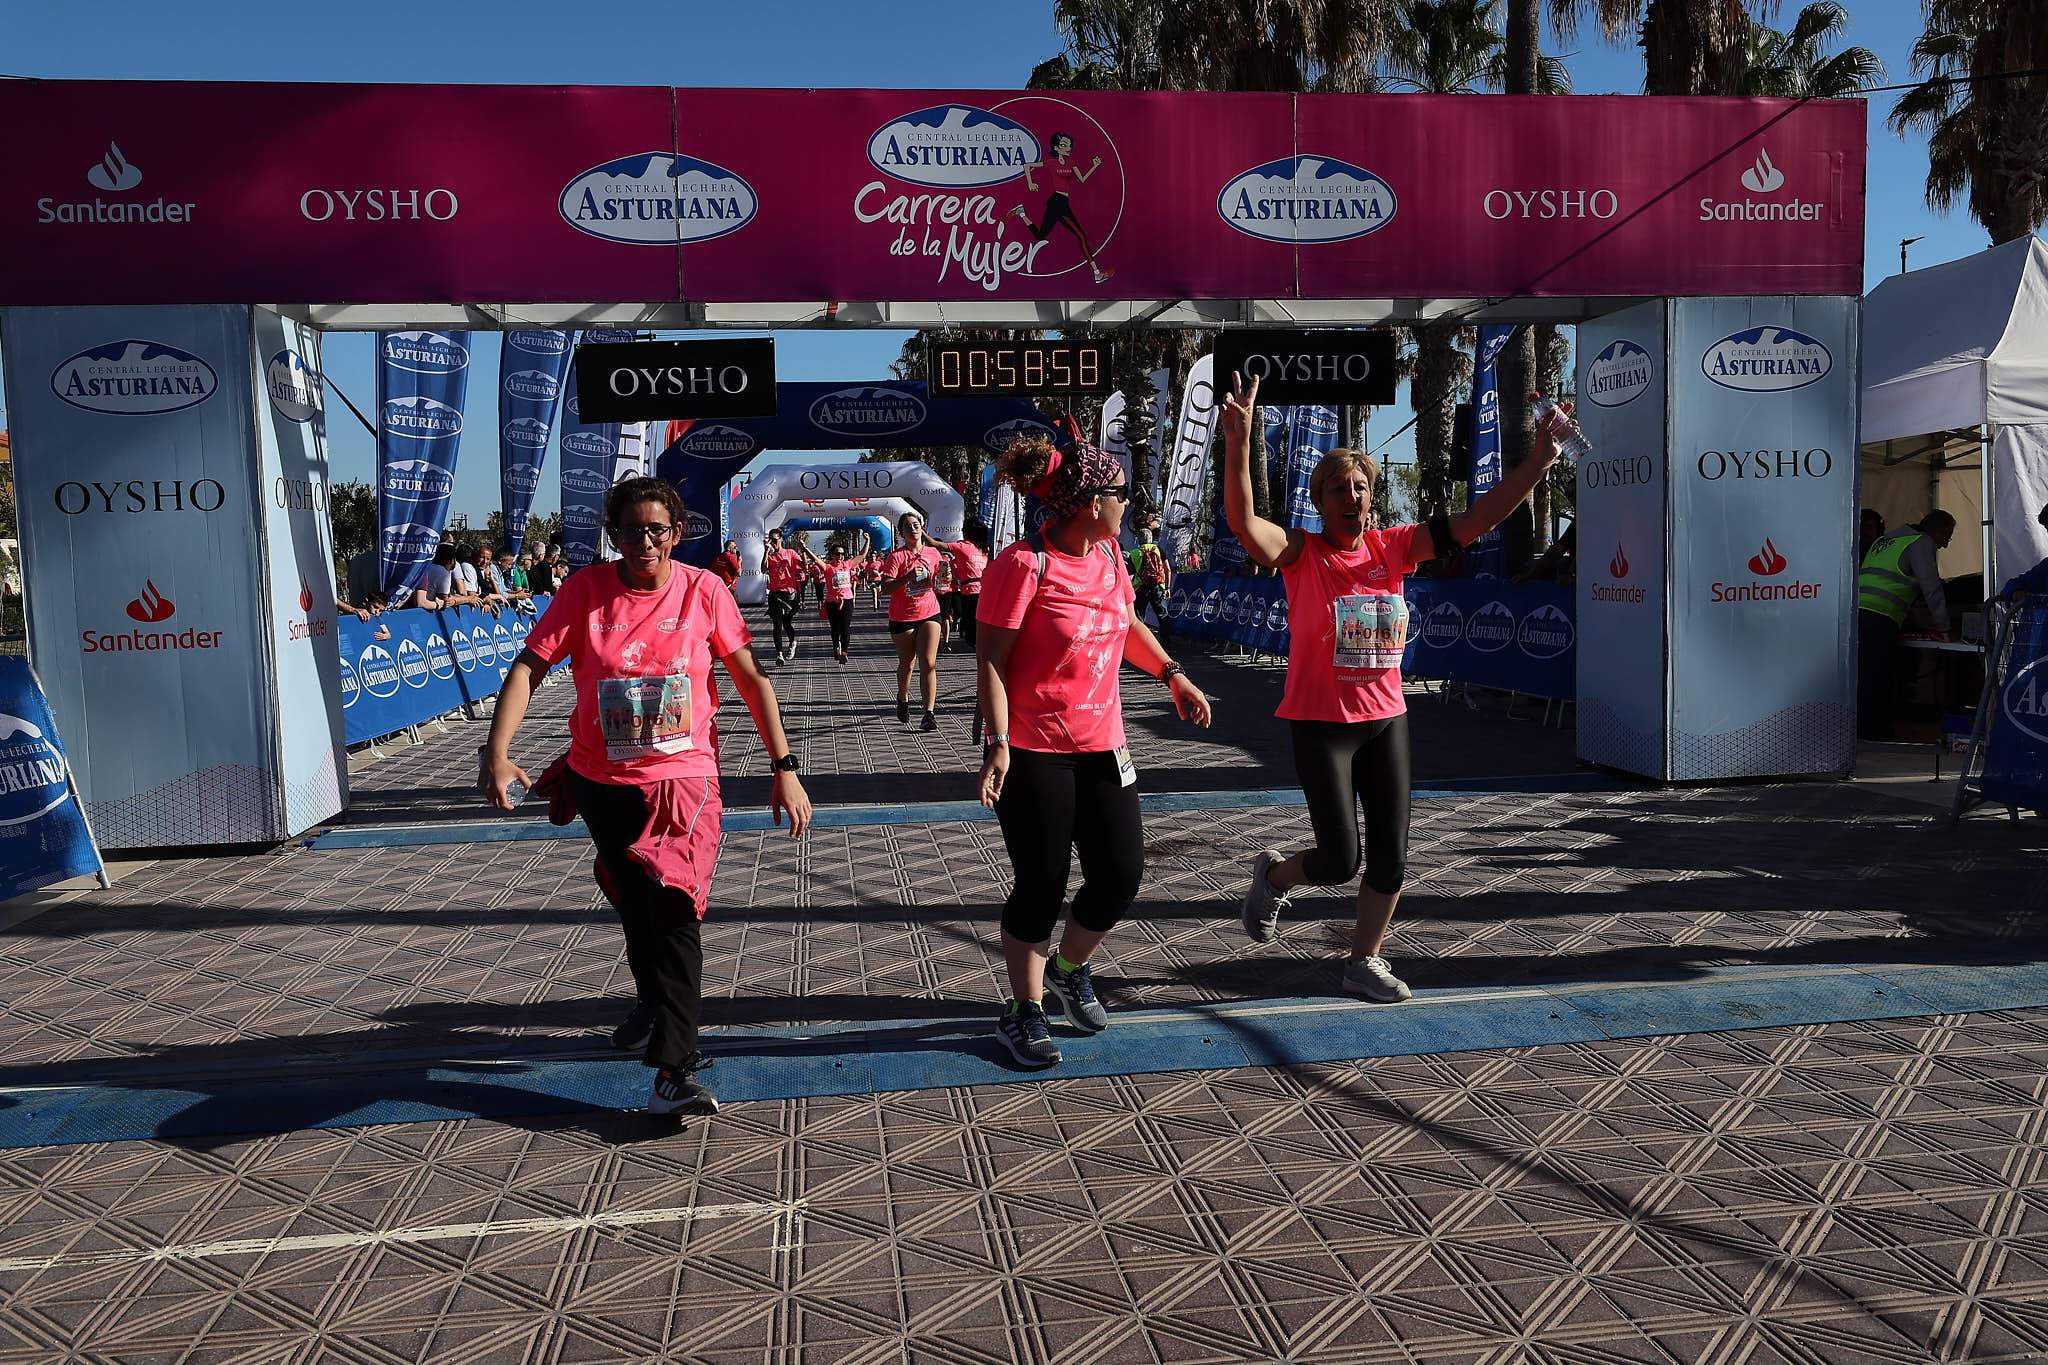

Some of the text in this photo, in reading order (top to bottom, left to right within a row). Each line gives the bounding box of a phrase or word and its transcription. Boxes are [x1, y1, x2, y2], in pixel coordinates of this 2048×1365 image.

[908, 133, 1022, 142] CENTRAL LECHERA
[881, 134, 1027, 167] ASTURIANA
[605, 184, 667, 194] CENTRAL
[1259, 185, 1377, 194] CENTRAL LECHERA
[37, 197, 196, 224] Santander
[300, 189, 459, 221] OYSHO
[575, 187, 743, 221] ASTURIANA
[854, 181, 997, 225] Carrera
[1232, 187, 1384, 220] ASTURIANA
[1484, 189, 1618, 219] OYSHO
[1699, 196, 1824, 221] Santander
[890, 221, 1049, 291] de la Mujer
[384, 341, 462, 366] ASTURIANA
[1711, 351, 1822, 376] ASTURIANA
[1731, 348, 1819, 357] CENTRAL LECHERA
[89, 366, 142, 375] CENTRAL
[941, 349, 1098, 388] 00:58:58
[1243, 353, 1370, 382] OYSHO
[65, 369, 206, 396] ASTURIANA
[609, 365, 749, 397] OYSHO
[1590, 367, 1648, 395] ASTURIANA
[818, 403, 919, 424] ASTURIANA
[1299, 415, 1337, 431] STURIANA
[685, 438, 749, 451] ASTURIANA
[1586, 455, 1653, 489] OYSHO
[1698, 448, 1832, 480] OYSHO
[386, 475, 450, 493] STURIANA
[800, 469, 893, 490] OYSHO
[54, 479, 226, 515] OYSHO
[275, 477, 325, 511] OYSHO
[744, 493, 774, 501] OYSHO
[1591, 583, 1648, 605] Santander
[1711, 580, 1822, 603] Santander
[83, 628, 223, 653] Santander
[288, 617, 328, 642] Santander
[1520, 622, 1568, 648] ASTURIANA
